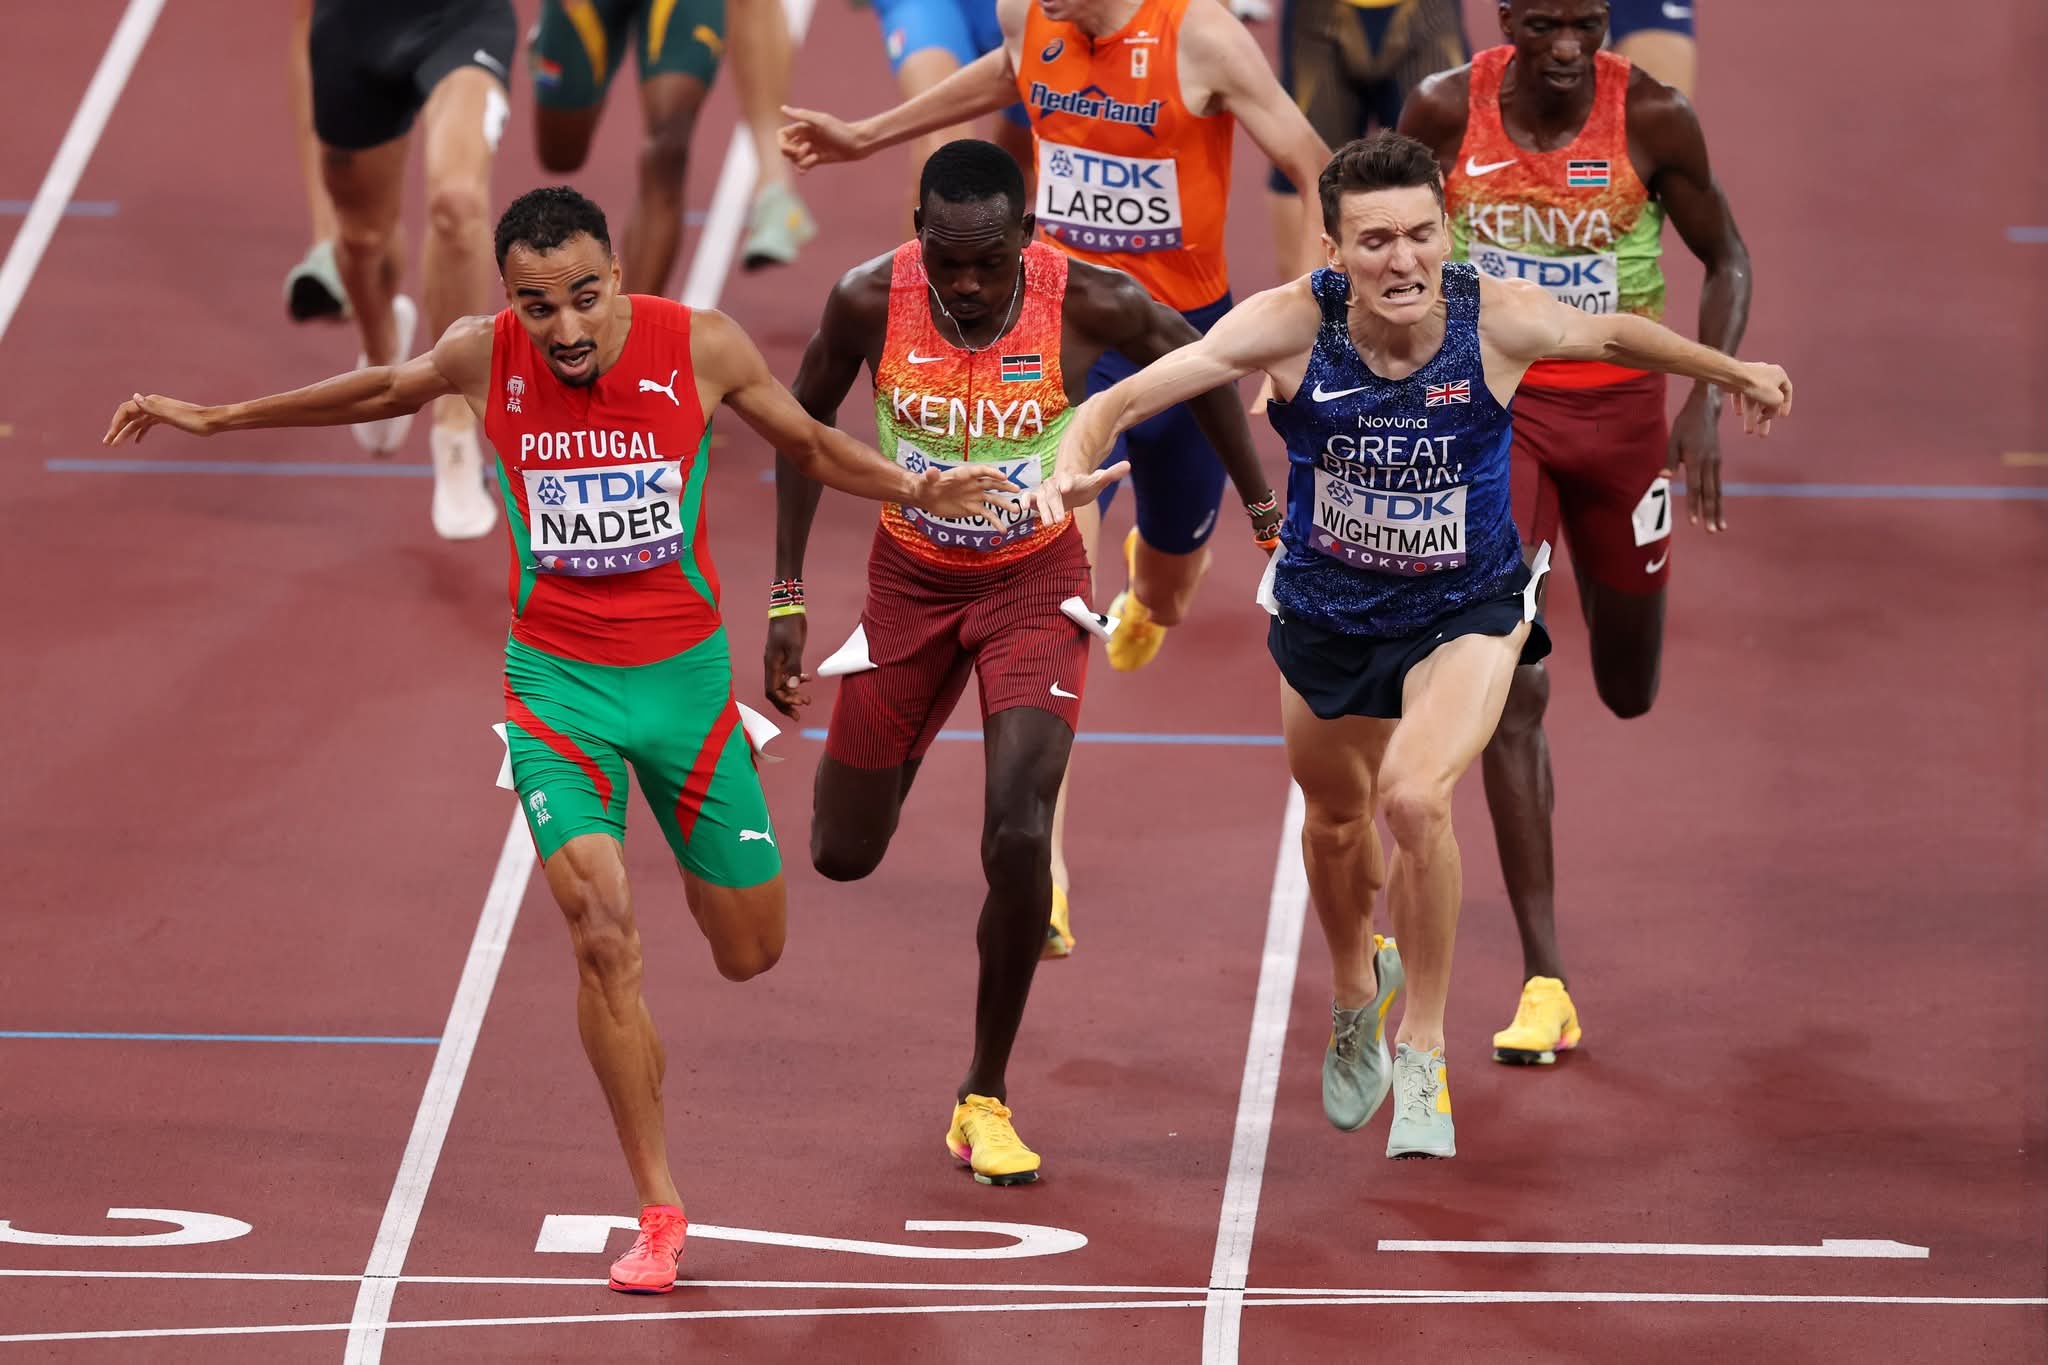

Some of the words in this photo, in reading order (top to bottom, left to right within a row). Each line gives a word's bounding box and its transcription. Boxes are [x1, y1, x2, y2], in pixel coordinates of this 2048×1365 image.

[1073, 153, 1166, 190] TDK
[1047, 185, 1171, 225] LAROS
[1468, 202, 1615, 247] KENYA
[1505, 256, 1604, 287] TDK
[506, 403, 522, 414] FPA
[892, 387, 1043, 439] KENYA
[1358, 415, 1428, 429] Novuna
[521, 430, 664, 461] PORTUGAL
[1326, 434, 1457, 466] GREAT
[563, 467, 669, 504] TDK
[541, 501, 673, 545] NADER
[1352, 488, 1456, 521] TDK
[1651, 487, 1666, 531] 7
[1320, 501, 1458, 555] WIGHTMAN
